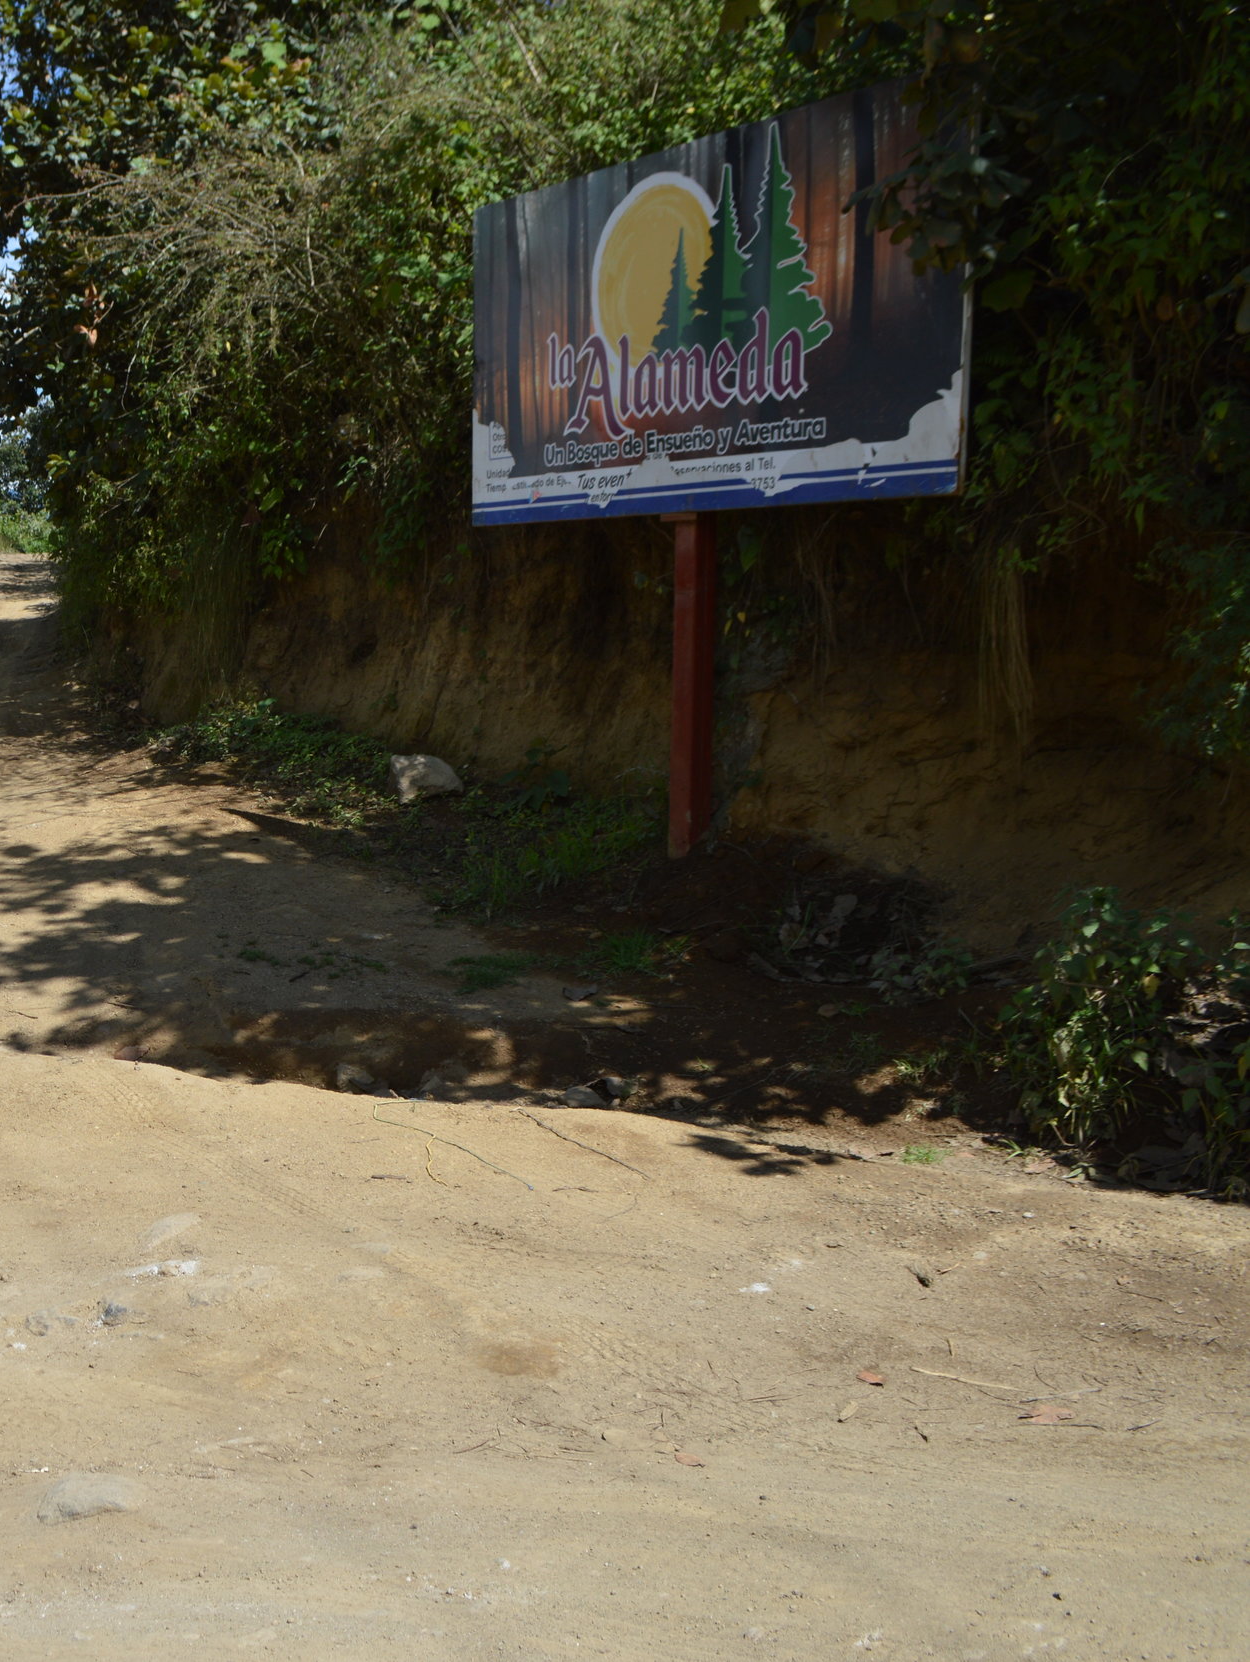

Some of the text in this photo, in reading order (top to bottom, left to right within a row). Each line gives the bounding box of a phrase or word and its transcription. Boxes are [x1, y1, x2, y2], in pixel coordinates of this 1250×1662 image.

[563, 306, 808, 440] Alameda
[544, 417, 827, 468] Un Bosque de Ensueño y Aventura
[744, 457, 755, 472] al
[758, 456, 776, 471] Tel.
[578, 473, 596, 490] Tus
